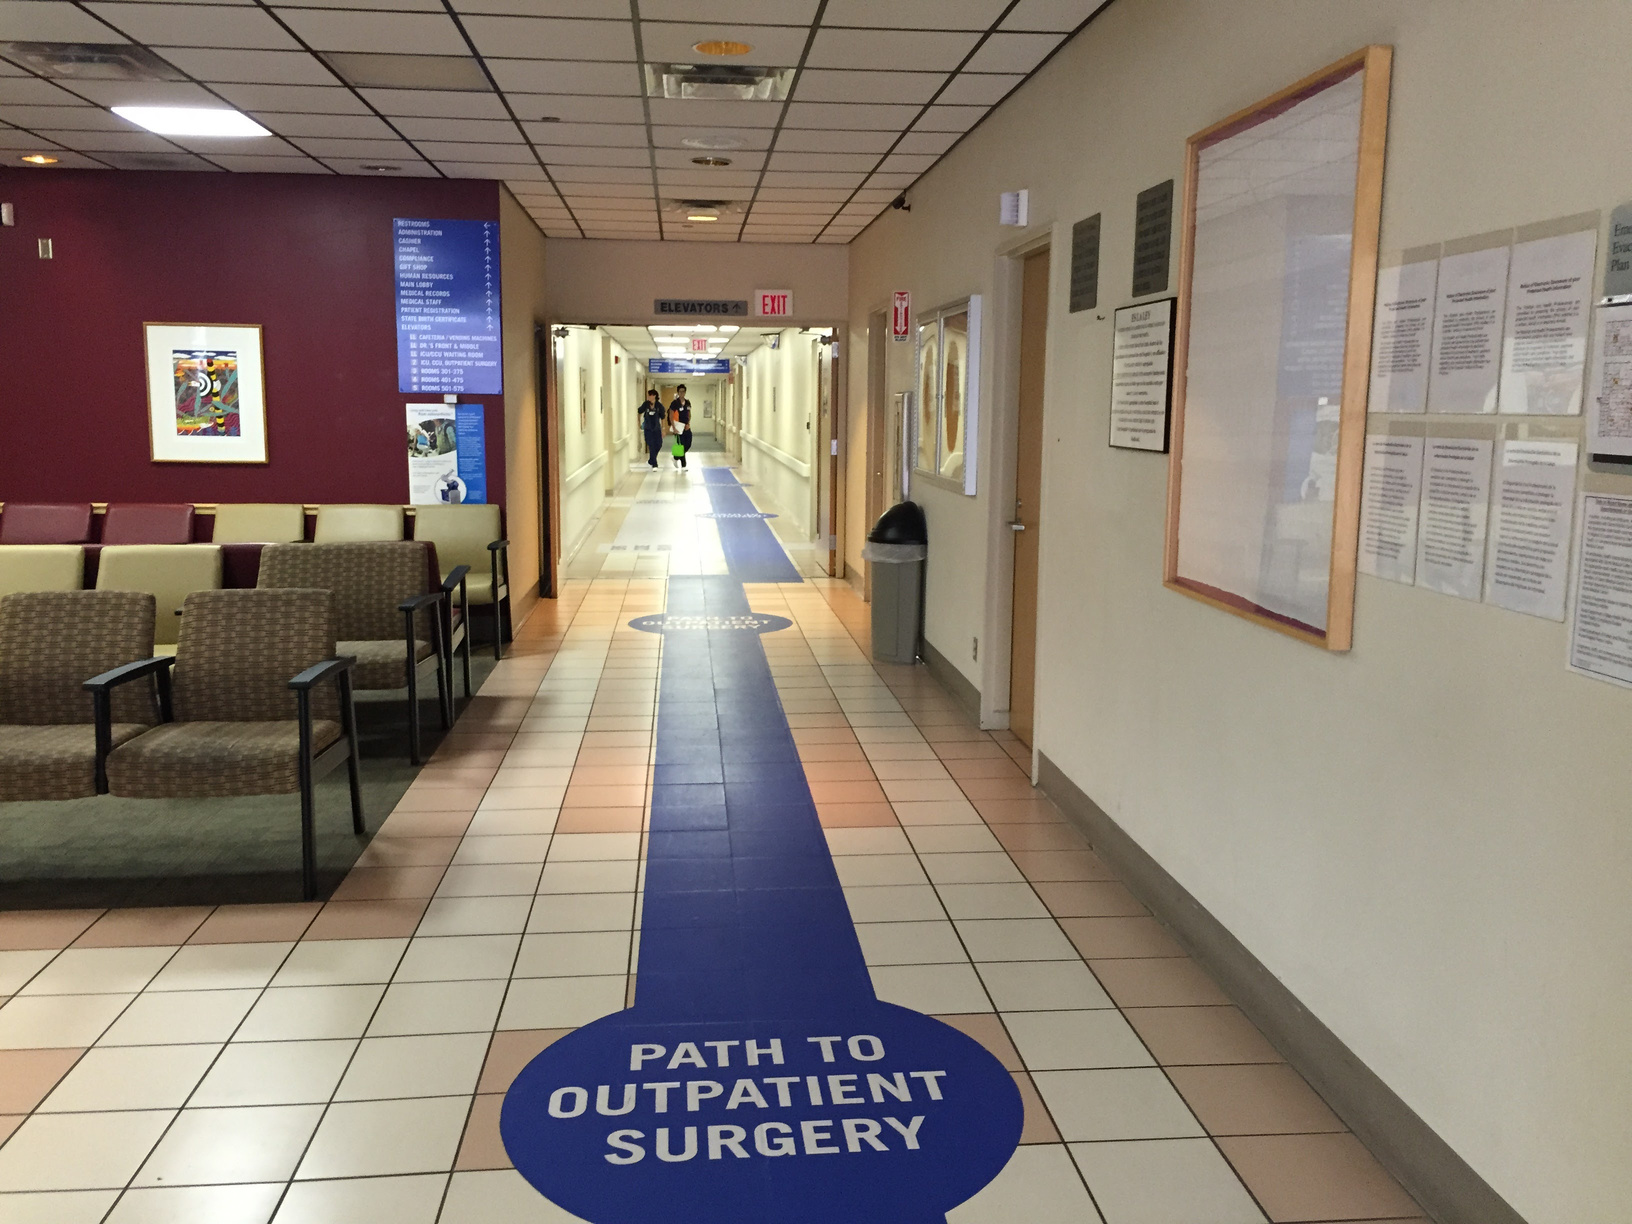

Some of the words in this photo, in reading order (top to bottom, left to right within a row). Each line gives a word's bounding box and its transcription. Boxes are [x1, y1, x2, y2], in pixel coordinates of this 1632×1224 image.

[1610, 258, 1630, 271] Plan
[660, 302, 729, 314] ELEVATORS
[762, 294, 787, 315] EXIT
[692, 339, 707, 351] EXIT
[629, 1037, 786, 1072] PATH
[807, 1034, 886, 1064] TO
[546, 1069, 948, 1120] OUTPATIENT
[603, 1114, 926, 1166] SURGERY
